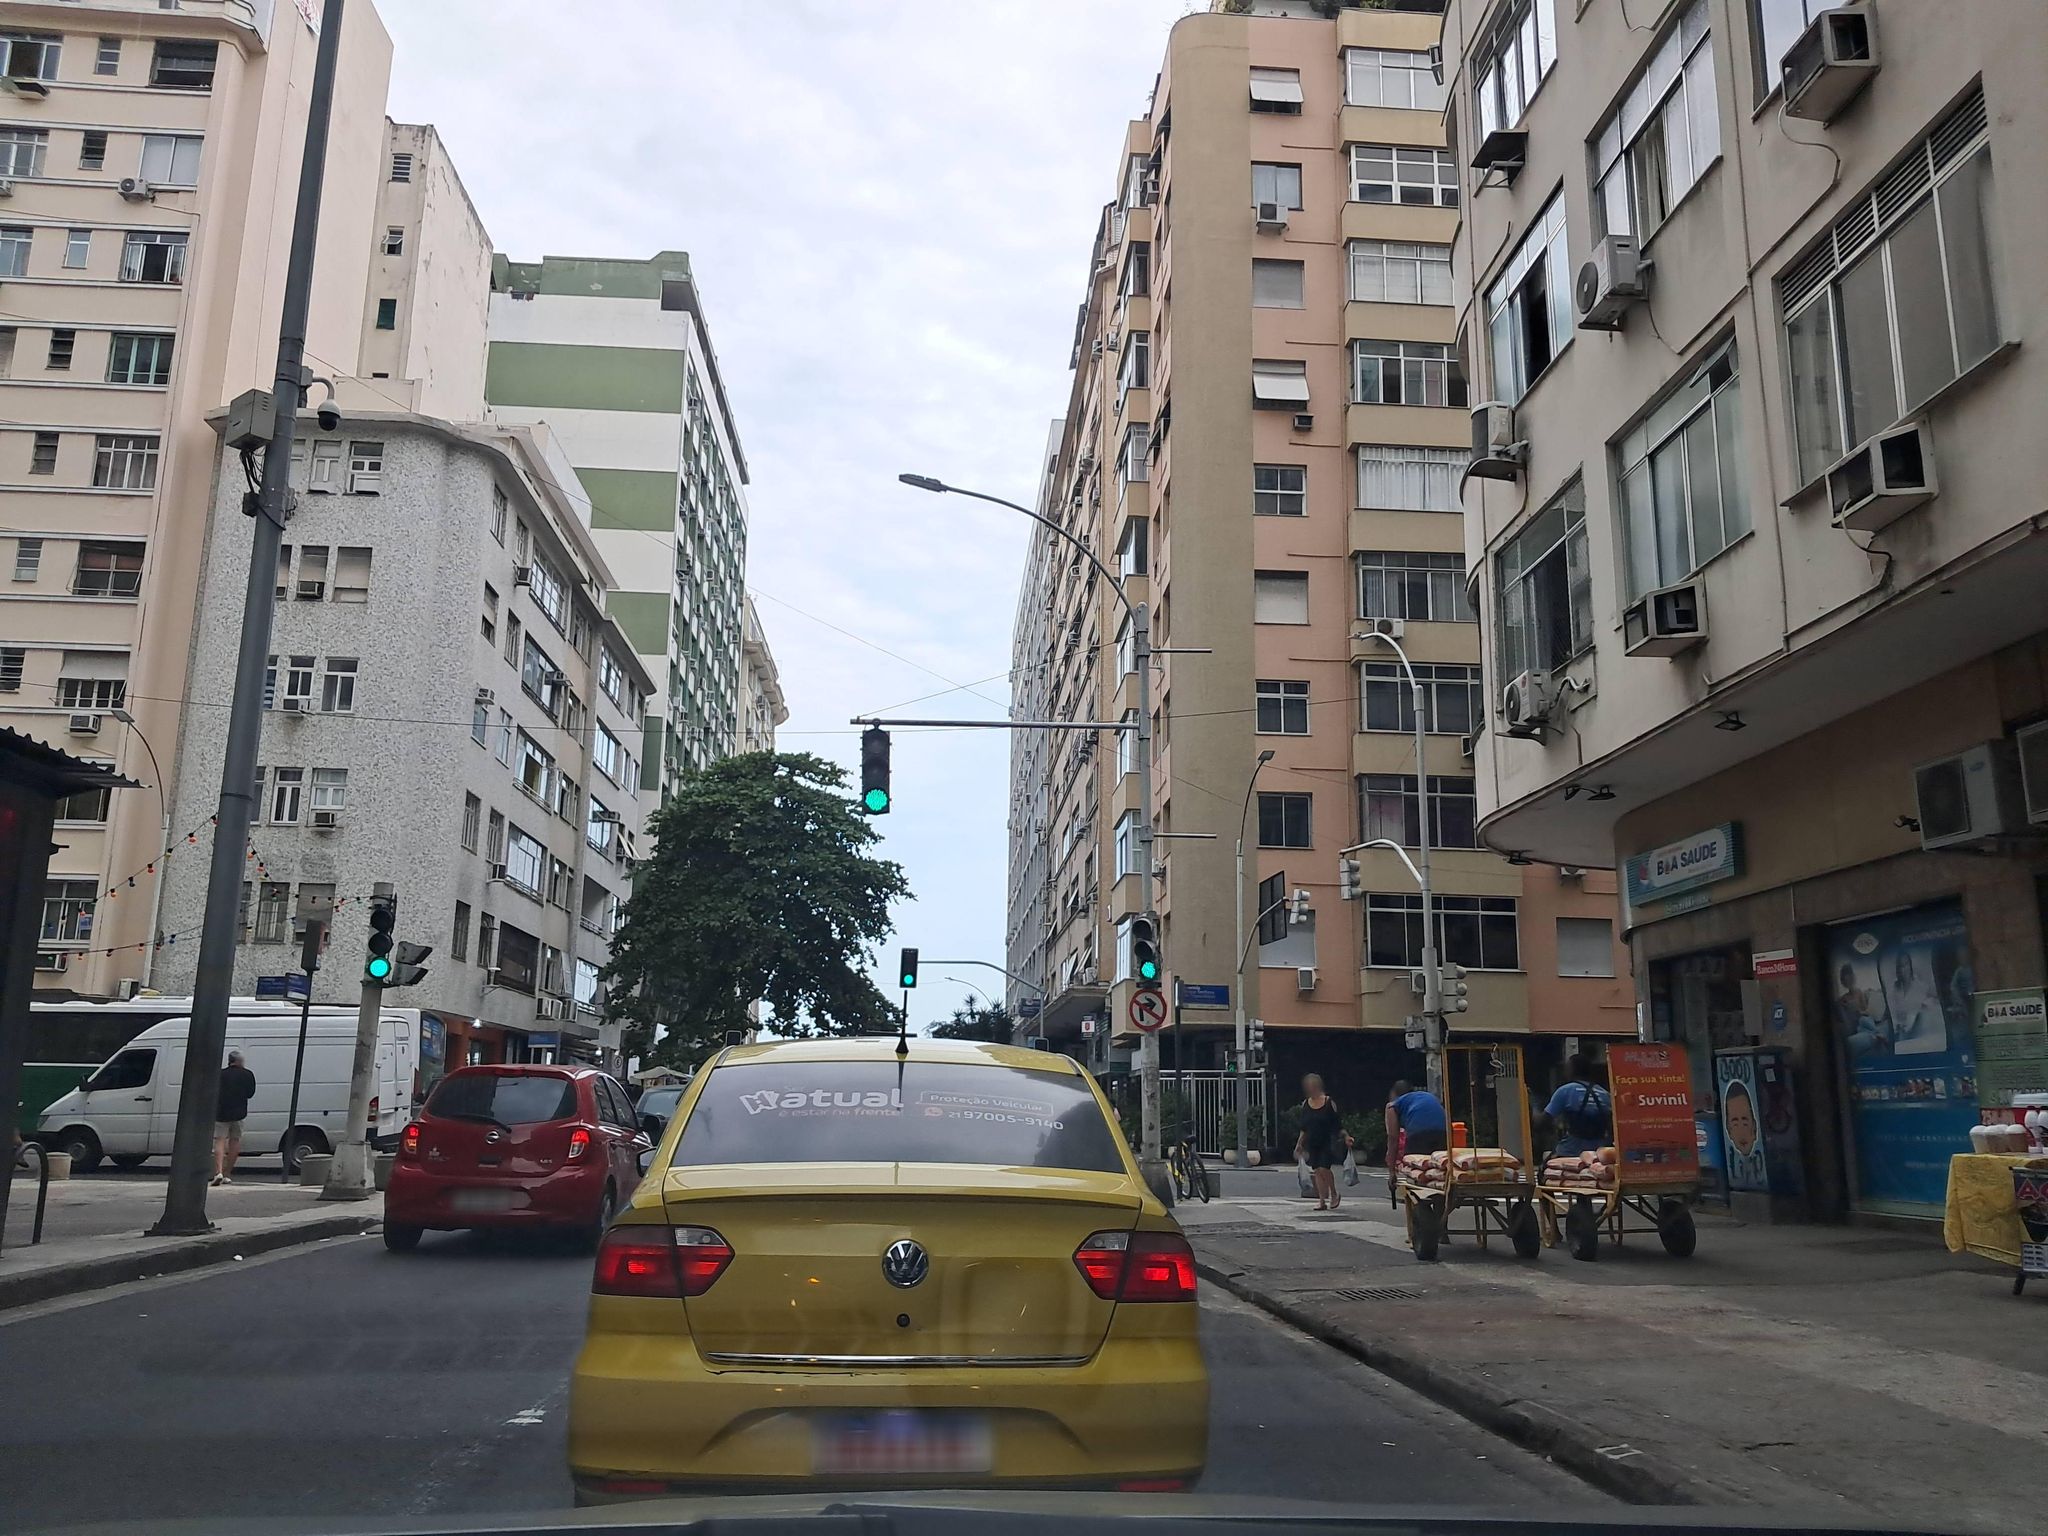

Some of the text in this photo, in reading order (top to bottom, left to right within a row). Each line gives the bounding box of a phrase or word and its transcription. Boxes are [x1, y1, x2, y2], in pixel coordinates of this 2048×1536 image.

[1615, 1073, 1685, 1085] Faça sua tinta!
[930, 1094, 989, 1106] Proteção
[1638, 1093, 1688, 1106] Suvinil
[963, 1111, 1064, 1130] 97005-9140
